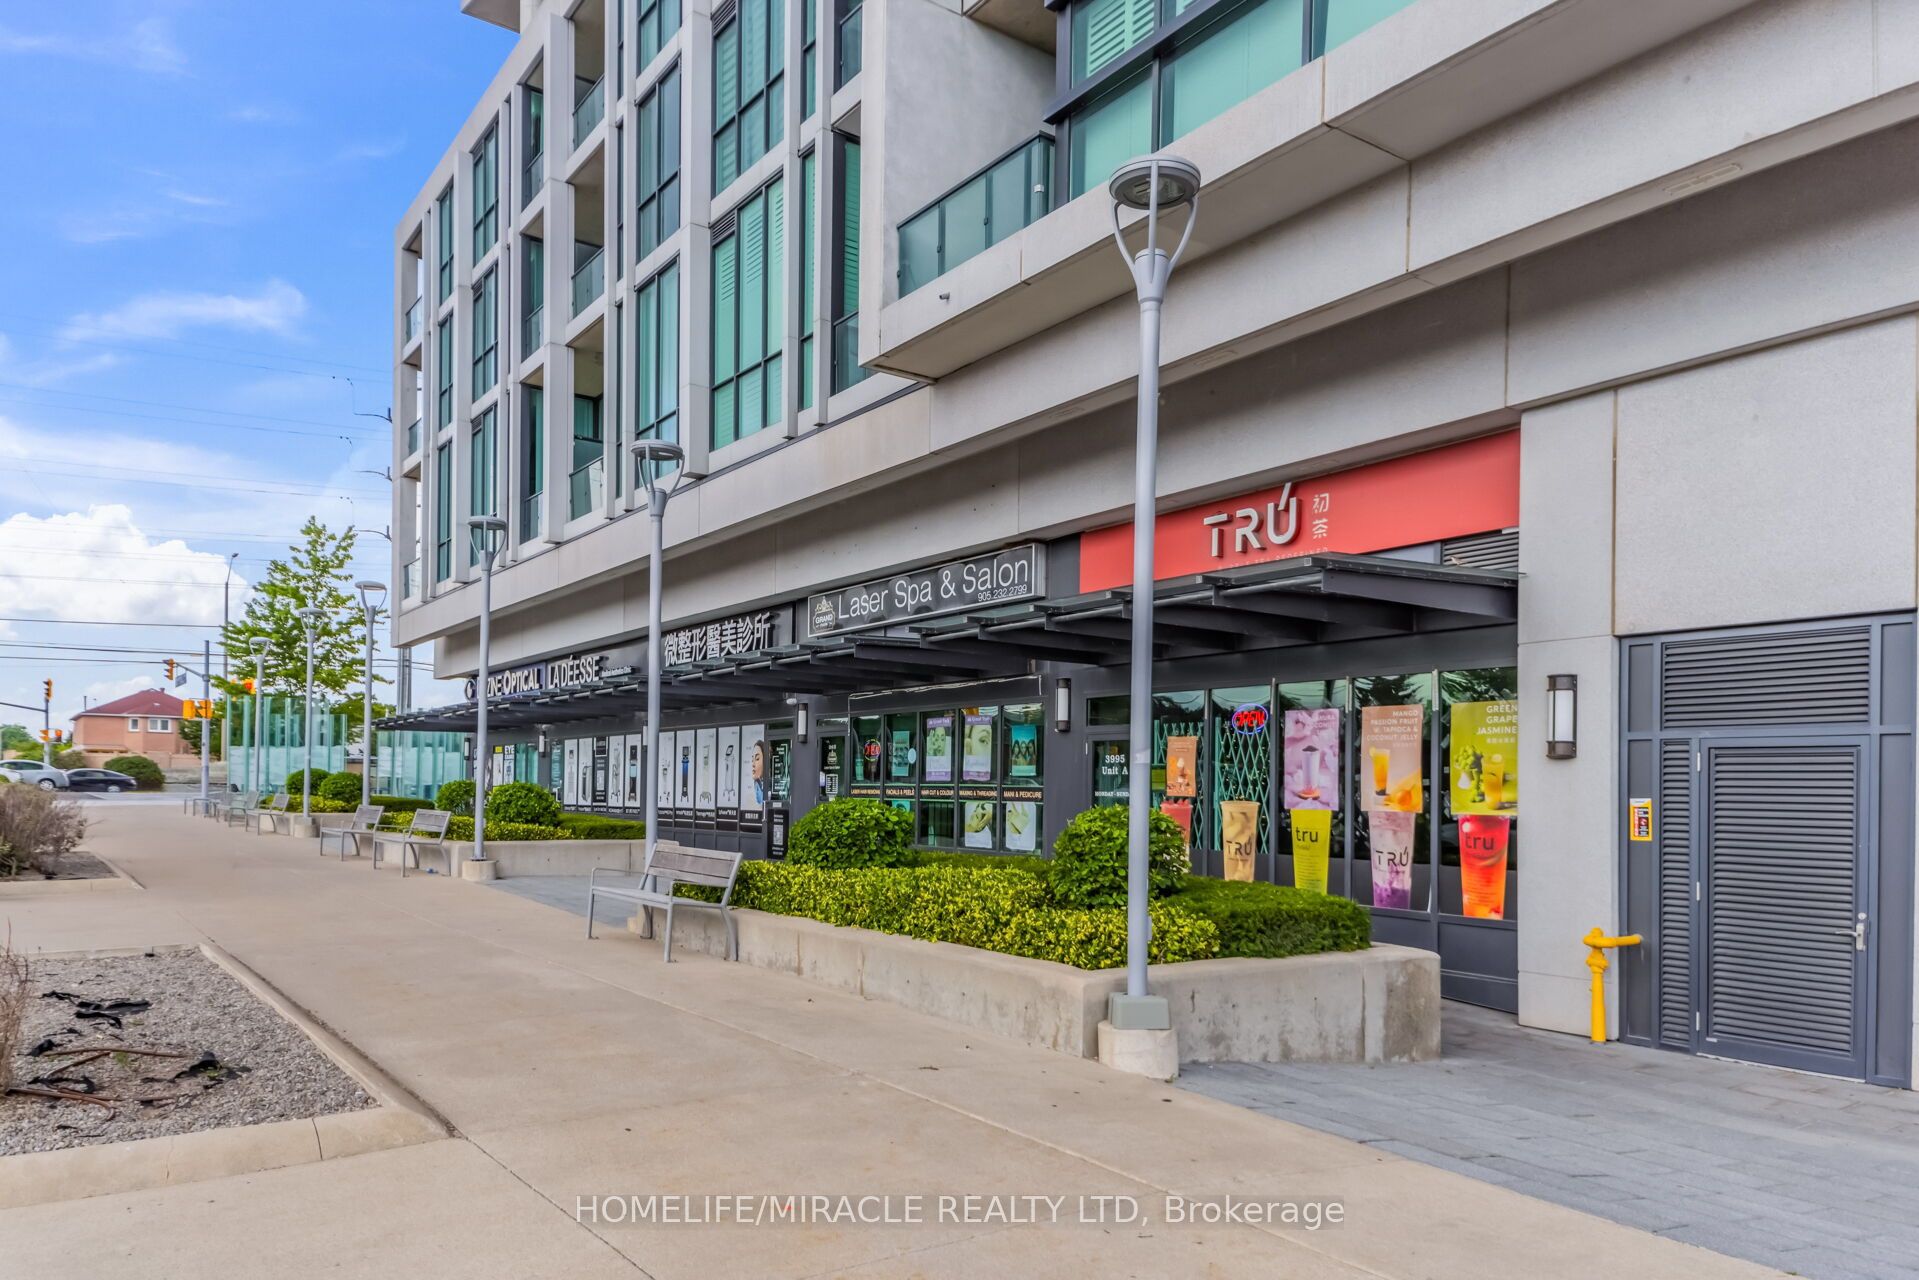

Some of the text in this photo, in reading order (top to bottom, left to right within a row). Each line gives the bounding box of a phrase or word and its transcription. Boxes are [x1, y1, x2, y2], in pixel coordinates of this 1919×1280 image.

[838, 558, 1028, 620] Laser Spa & Salon
[977, 585, 1028, 602] 905.232.2799
[815, 613, 833, 624] GRAND
[664, 612, 771, 667] 微整形醫美診所
[548, 655, 600, 688] LA DÉESSE
[503, 667, 540, 695] OPTICAL
[1486, 703, 1518, 713] GREEN
[1234, 710, 1265, 727] OPEN
[1486, 715, 1518, 724] GRAPE
[1476, 725, 1518, 735] JASMINE
[504, 745, 515, 754] EYE
[1105, 754, 1125, 763] 3995
[1101, 766, 1129, 775] Unit A
[1295, 826, 1318, 843] tru
[1464, 832, 1495, 850] tru
